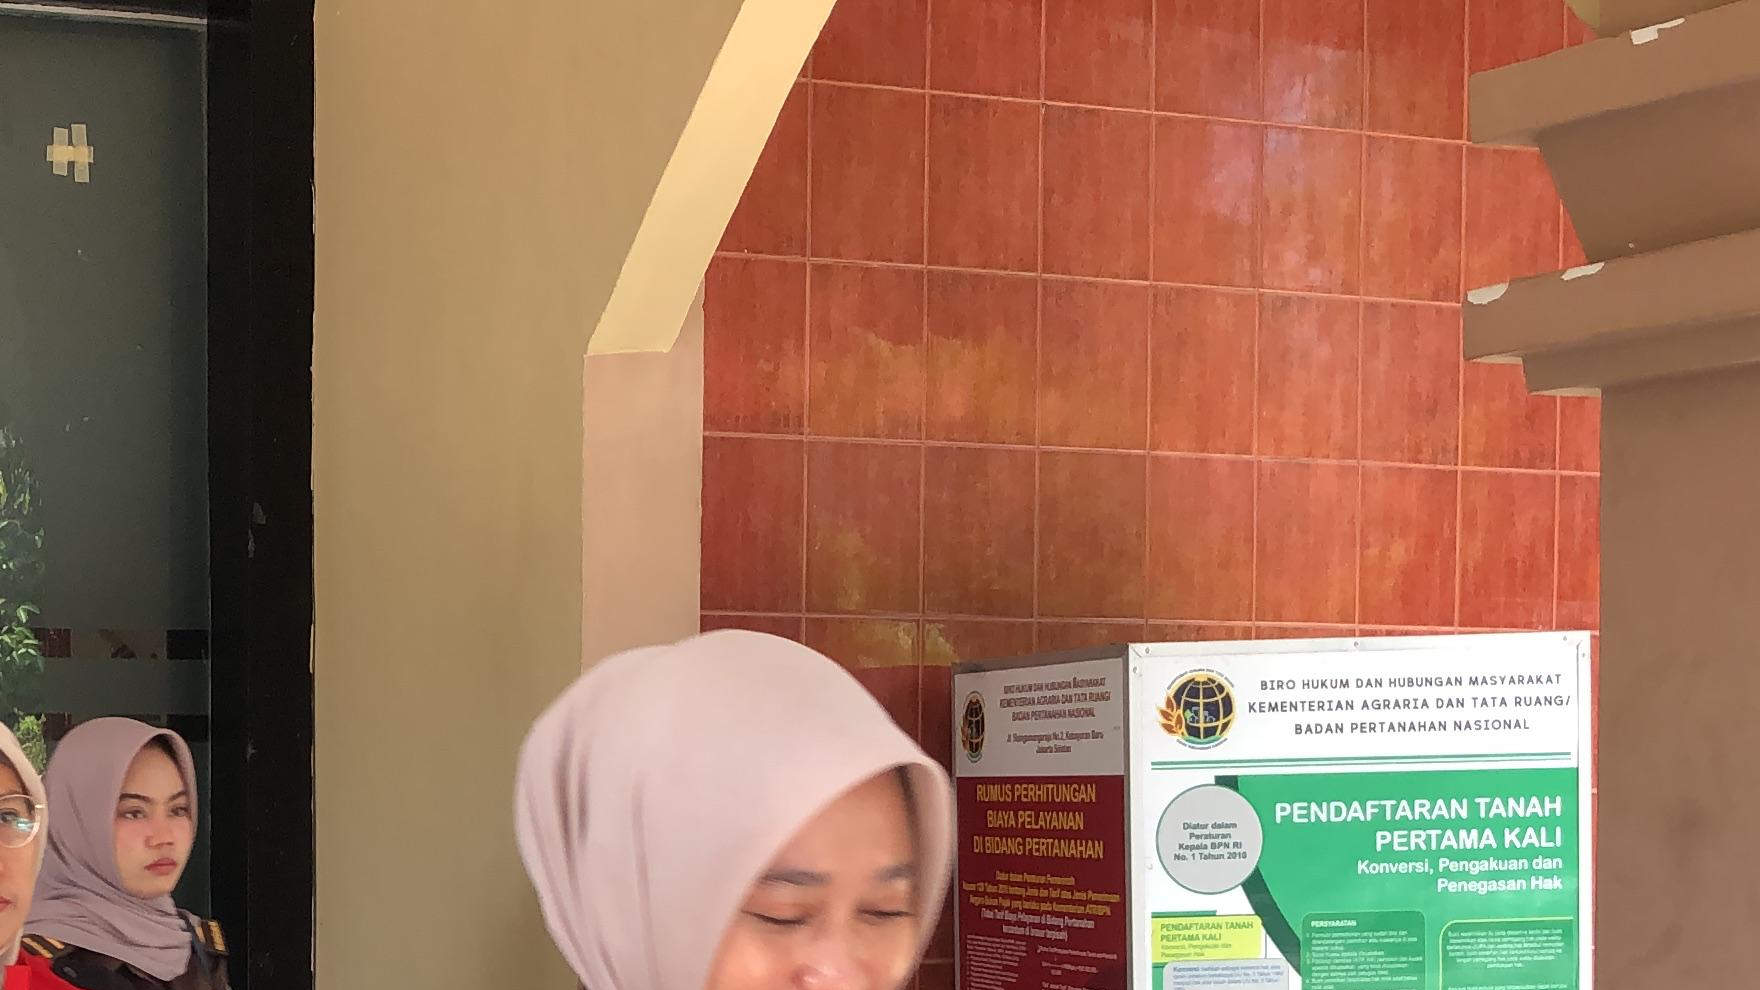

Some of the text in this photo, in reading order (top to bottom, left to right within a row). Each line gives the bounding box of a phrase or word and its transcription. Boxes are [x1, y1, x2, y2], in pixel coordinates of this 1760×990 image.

[1260, 674, 1562, 691] BIRO HUKUM DAN HUBUNGAN MASYARAKAT
[1248, 695, 1570, 714] KEMENTERIAN AGRARIA DAN TATA RUANG/
[1295, 719, 1530, 735] BADAN PERTANAHAN NASIONAL
[977, 784, 1096, 802] RUMUS PERHITUNGAN
[1275, 795, 1562, 824] PENDAFTARAN TANAH
[987, 810, 1083, 830] BIAYA PELAYANAN
[1183, 822, 1209, 830] Diatur
[1190, 832, 1231, 840] Peraturan
[1375, 826, 1562, 852] PERTAMA KALI
[974, 836, 1103, 859] DI BIDANG PERTANAHAN
[1179, 843, 1208, 851] Kepala
[1357, 856, 1562, 876] Konversi, Pengakuan dan
[1437, 875, 1562, 895] Penegasan Hak
[1160, 921, 1253, 931] PENDAFTARAN TANAH
[1311, 920, 1356, 928] PERSYARATAN
[1160, 933, 1221, 942] PERTAMA KALI
